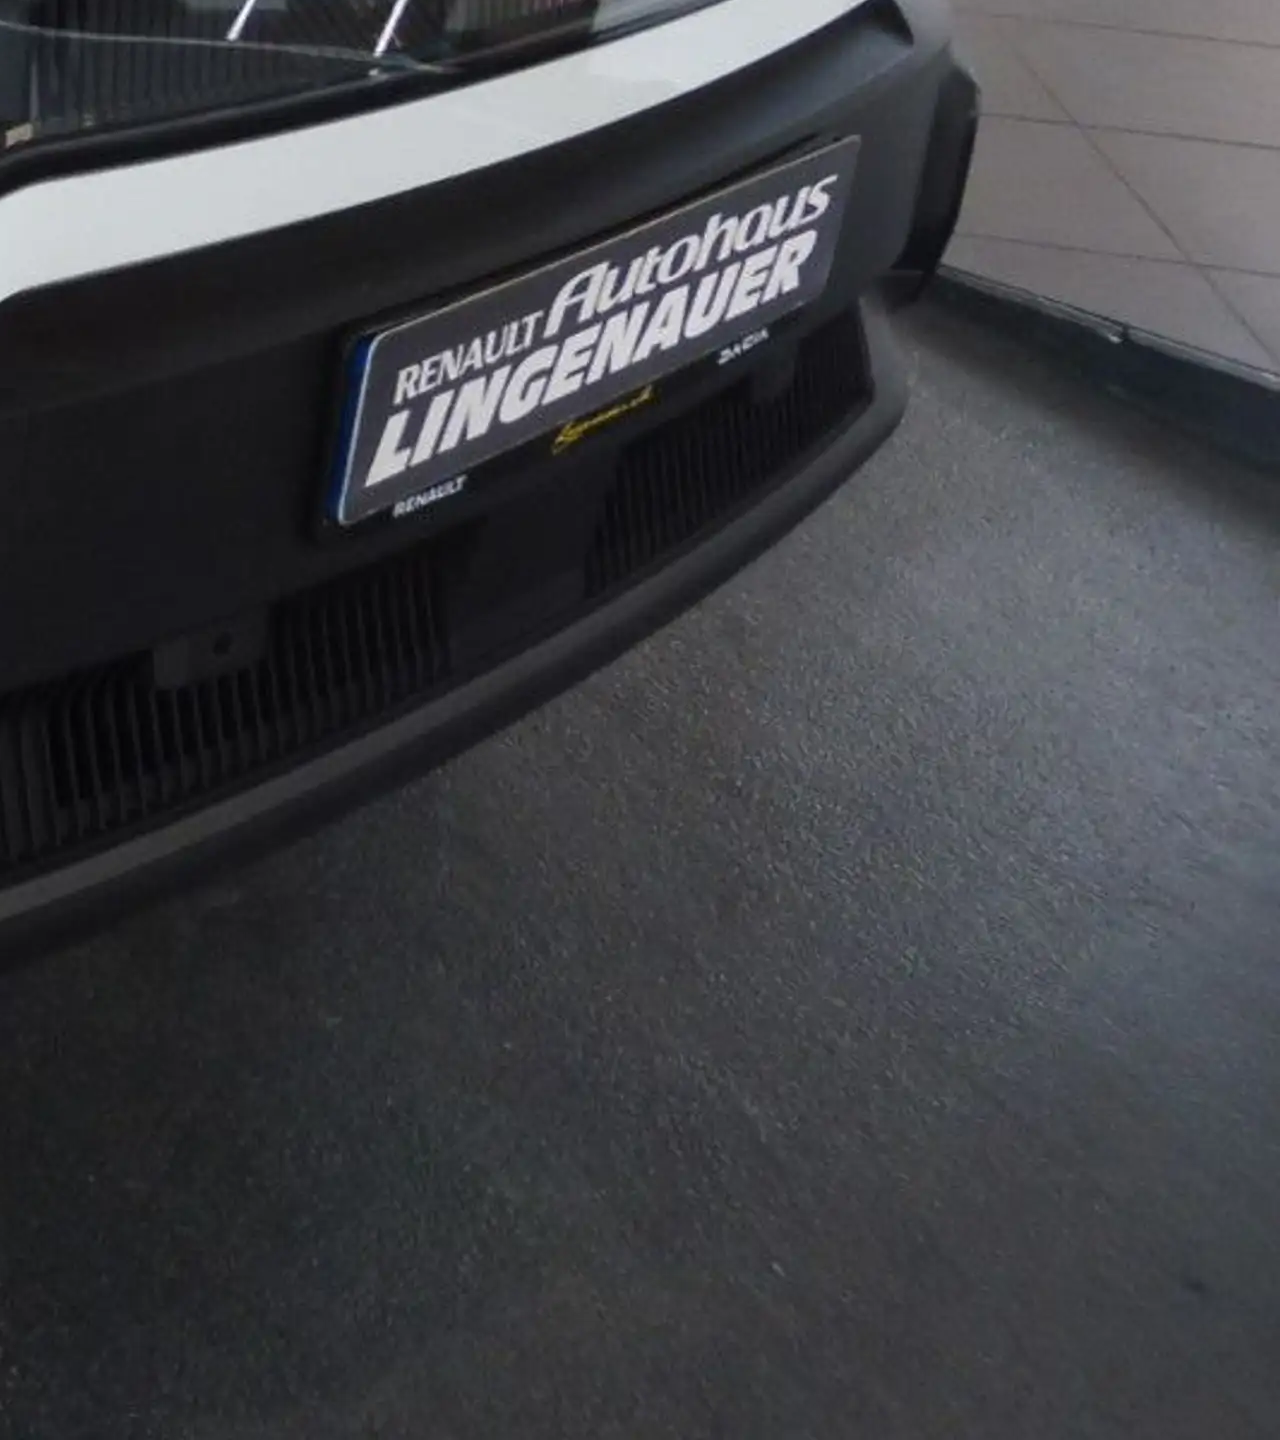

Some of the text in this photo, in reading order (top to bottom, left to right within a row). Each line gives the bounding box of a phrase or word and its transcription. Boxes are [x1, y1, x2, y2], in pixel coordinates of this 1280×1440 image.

[364, 229, 818, 488] LINGENAUER
[393, 174, 838, 405] RENAULT Autohaus
[393, 474, 468, 517] RENAULT
